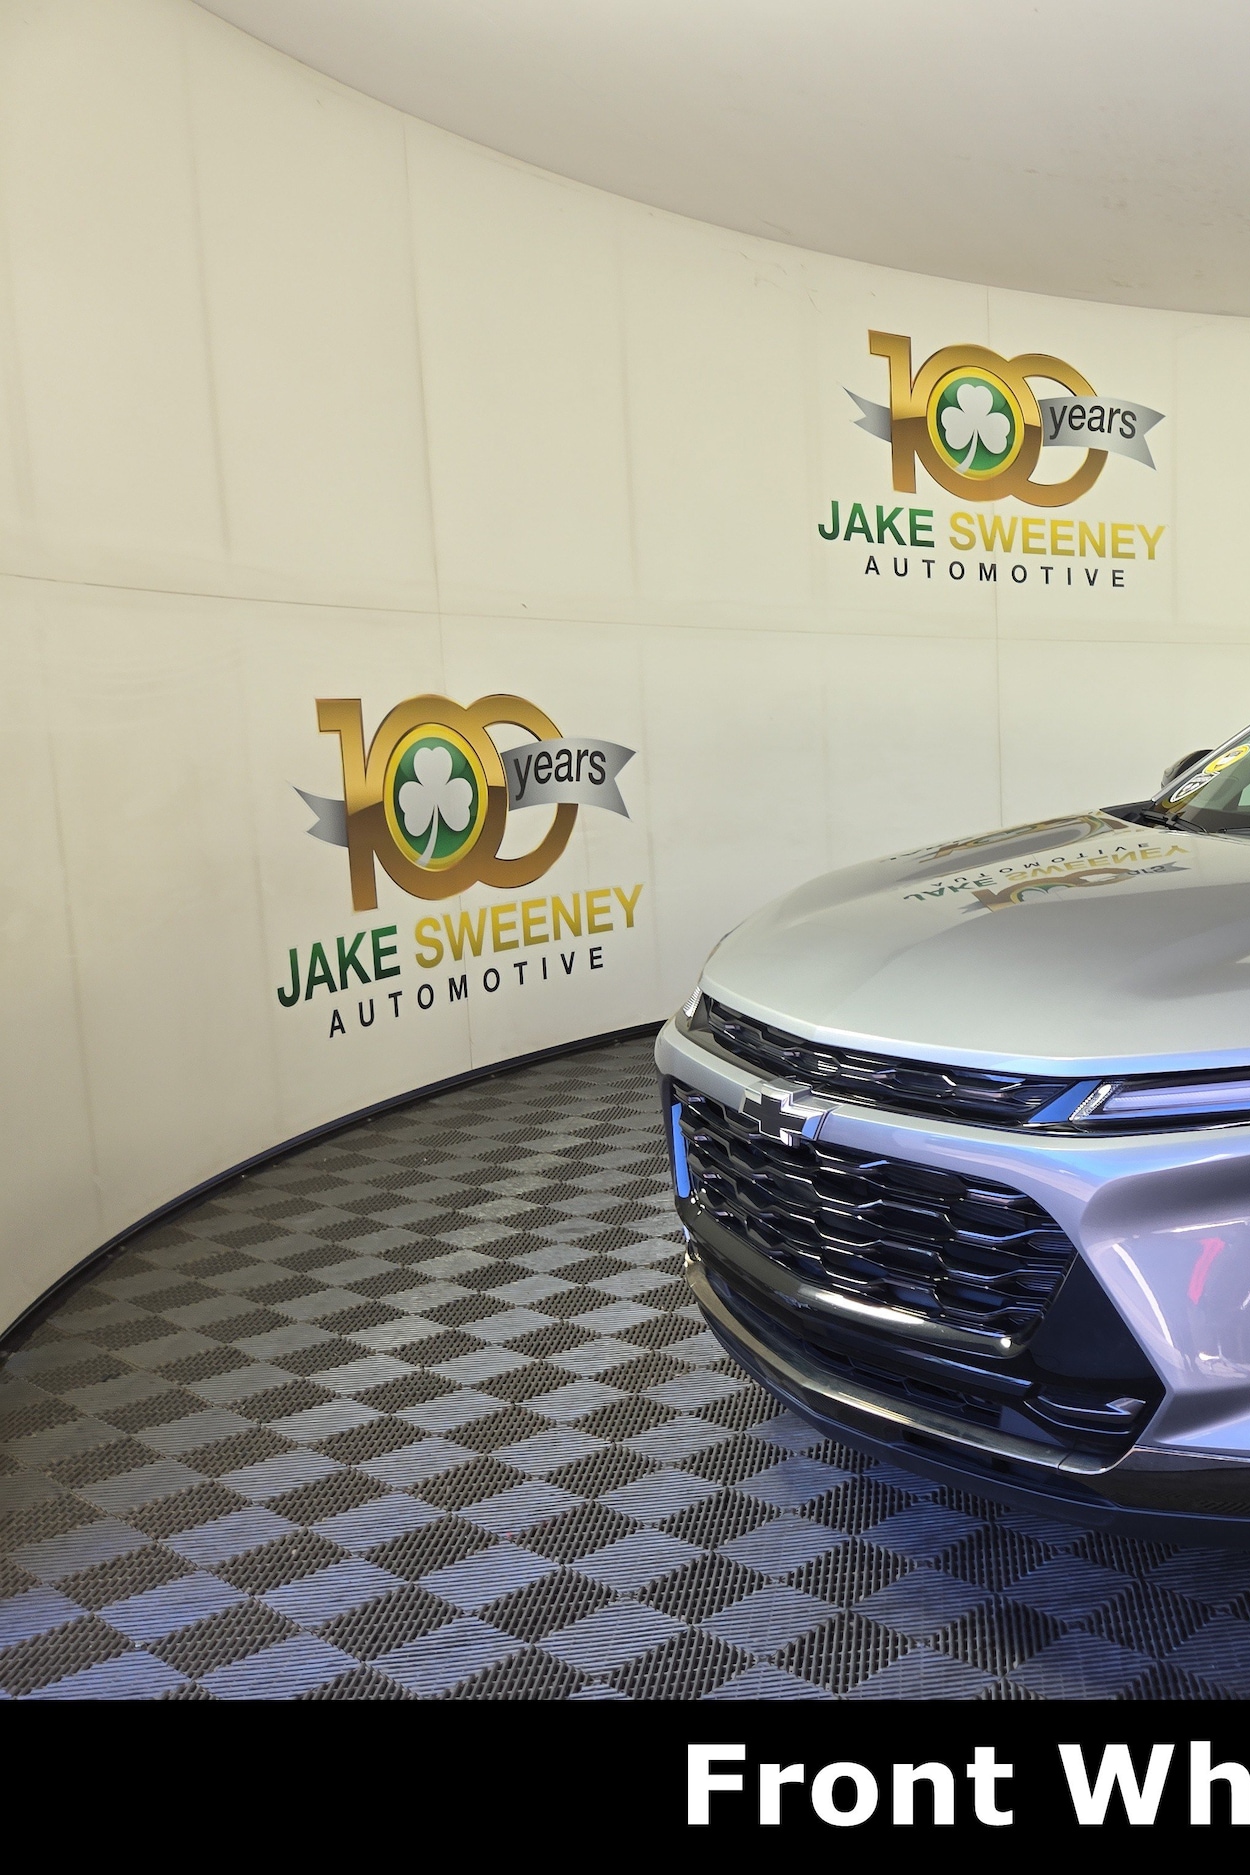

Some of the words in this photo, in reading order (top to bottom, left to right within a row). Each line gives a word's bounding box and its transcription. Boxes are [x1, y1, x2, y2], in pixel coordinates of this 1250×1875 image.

[1048, 403, 1138, 440] years
[817, 500, 935, 548] JAKE
[949, 511, 1166, 560] SWEENEY
[864, 555, 1126, 588] AUTOMOTIVE
[513, 748, 607, 800] years
[276, 925, 402, 1008] JAKE
[414, 884, 644, 969] SWEENEY
[328, 946, 604, 1039] AUTOMOTIVE
